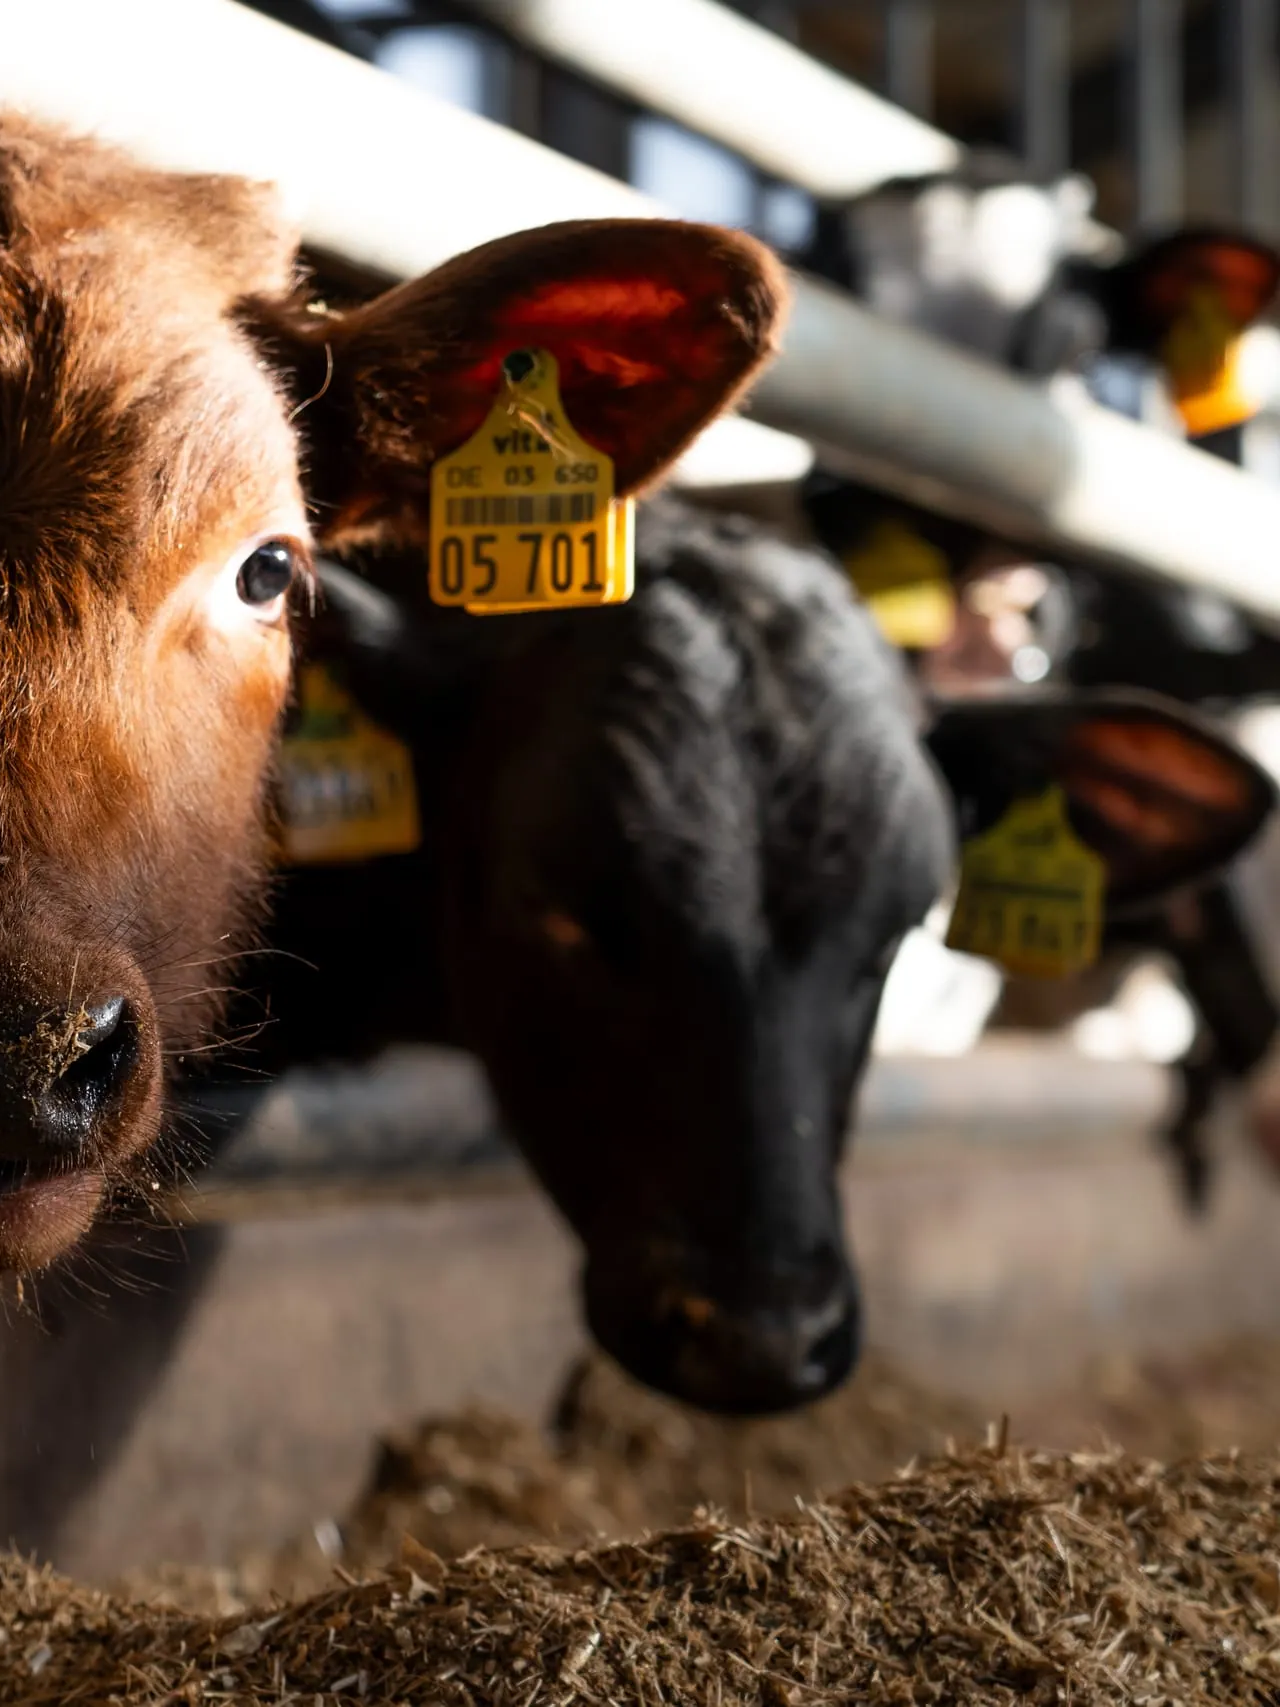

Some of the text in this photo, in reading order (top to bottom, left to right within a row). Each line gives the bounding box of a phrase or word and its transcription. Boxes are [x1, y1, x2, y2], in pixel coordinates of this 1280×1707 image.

[446, 463, 599, 489] DE 03 650
[440, 531, 604, 597] 05 701
